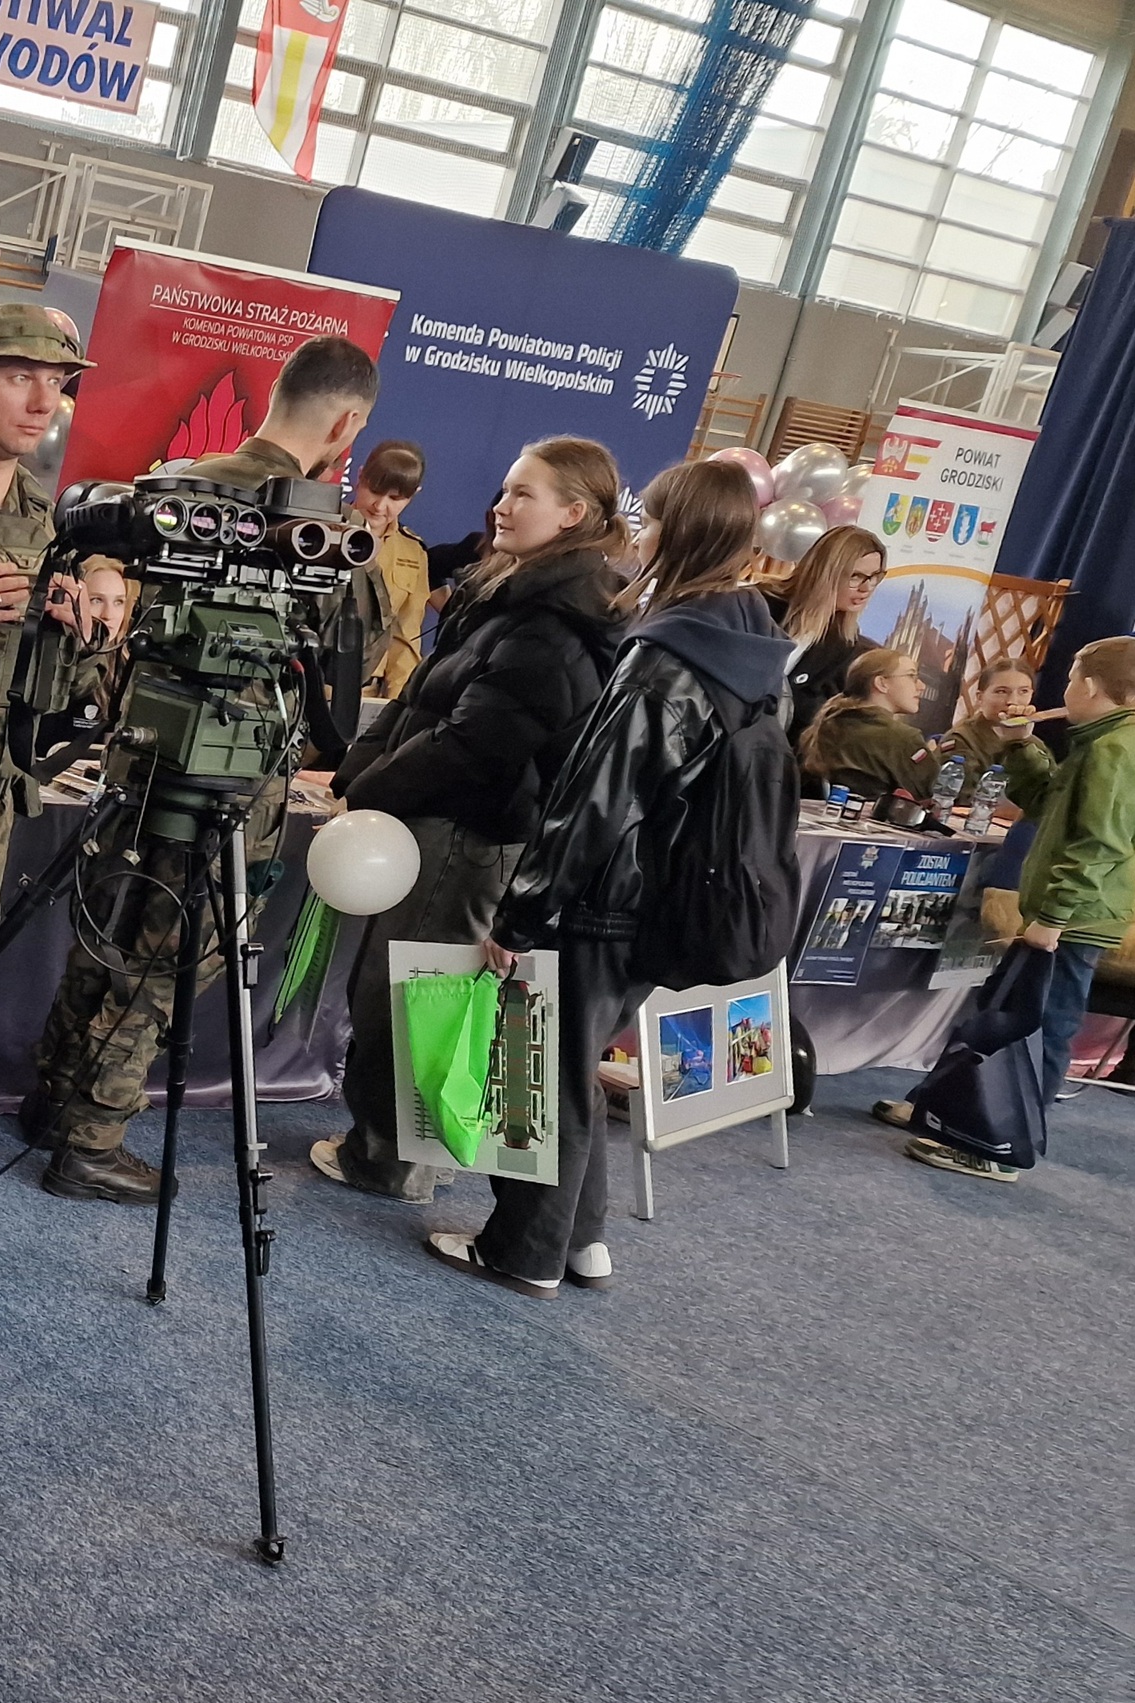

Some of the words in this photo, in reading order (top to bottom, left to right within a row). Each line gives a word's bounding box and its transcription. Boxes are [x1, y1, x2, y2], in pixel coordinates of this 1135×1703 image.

[152, 283, 243, 317] PAŃSTWOWA
[245, 301, 288, 326] STRAŻ
[289, 309, 349, 336] POŻARNA
[182, 317, 225, 336] KOMENDA
[225, 325, 276, 345] POWIATOWA
[277, 334, 294, 347] PSP
[182, 333, 231, 353] GRODZISKU
[410, 313, 485, 346] Komenda
[487, 328, 574, 361] Powiatowa
[576, 343, 624, 373] Policji
[424, 345, 502, 376] Grodzisku
[504, 359, 614, 395] Wielkopolskim
[956, 447, 1002, 468] POWIAT
[940, 468, 1004, 492] GRODZISKI
[916, 853, 951, 870] ZOSTAŃ
[901, 871, 957, 888] POLICJANTEM
